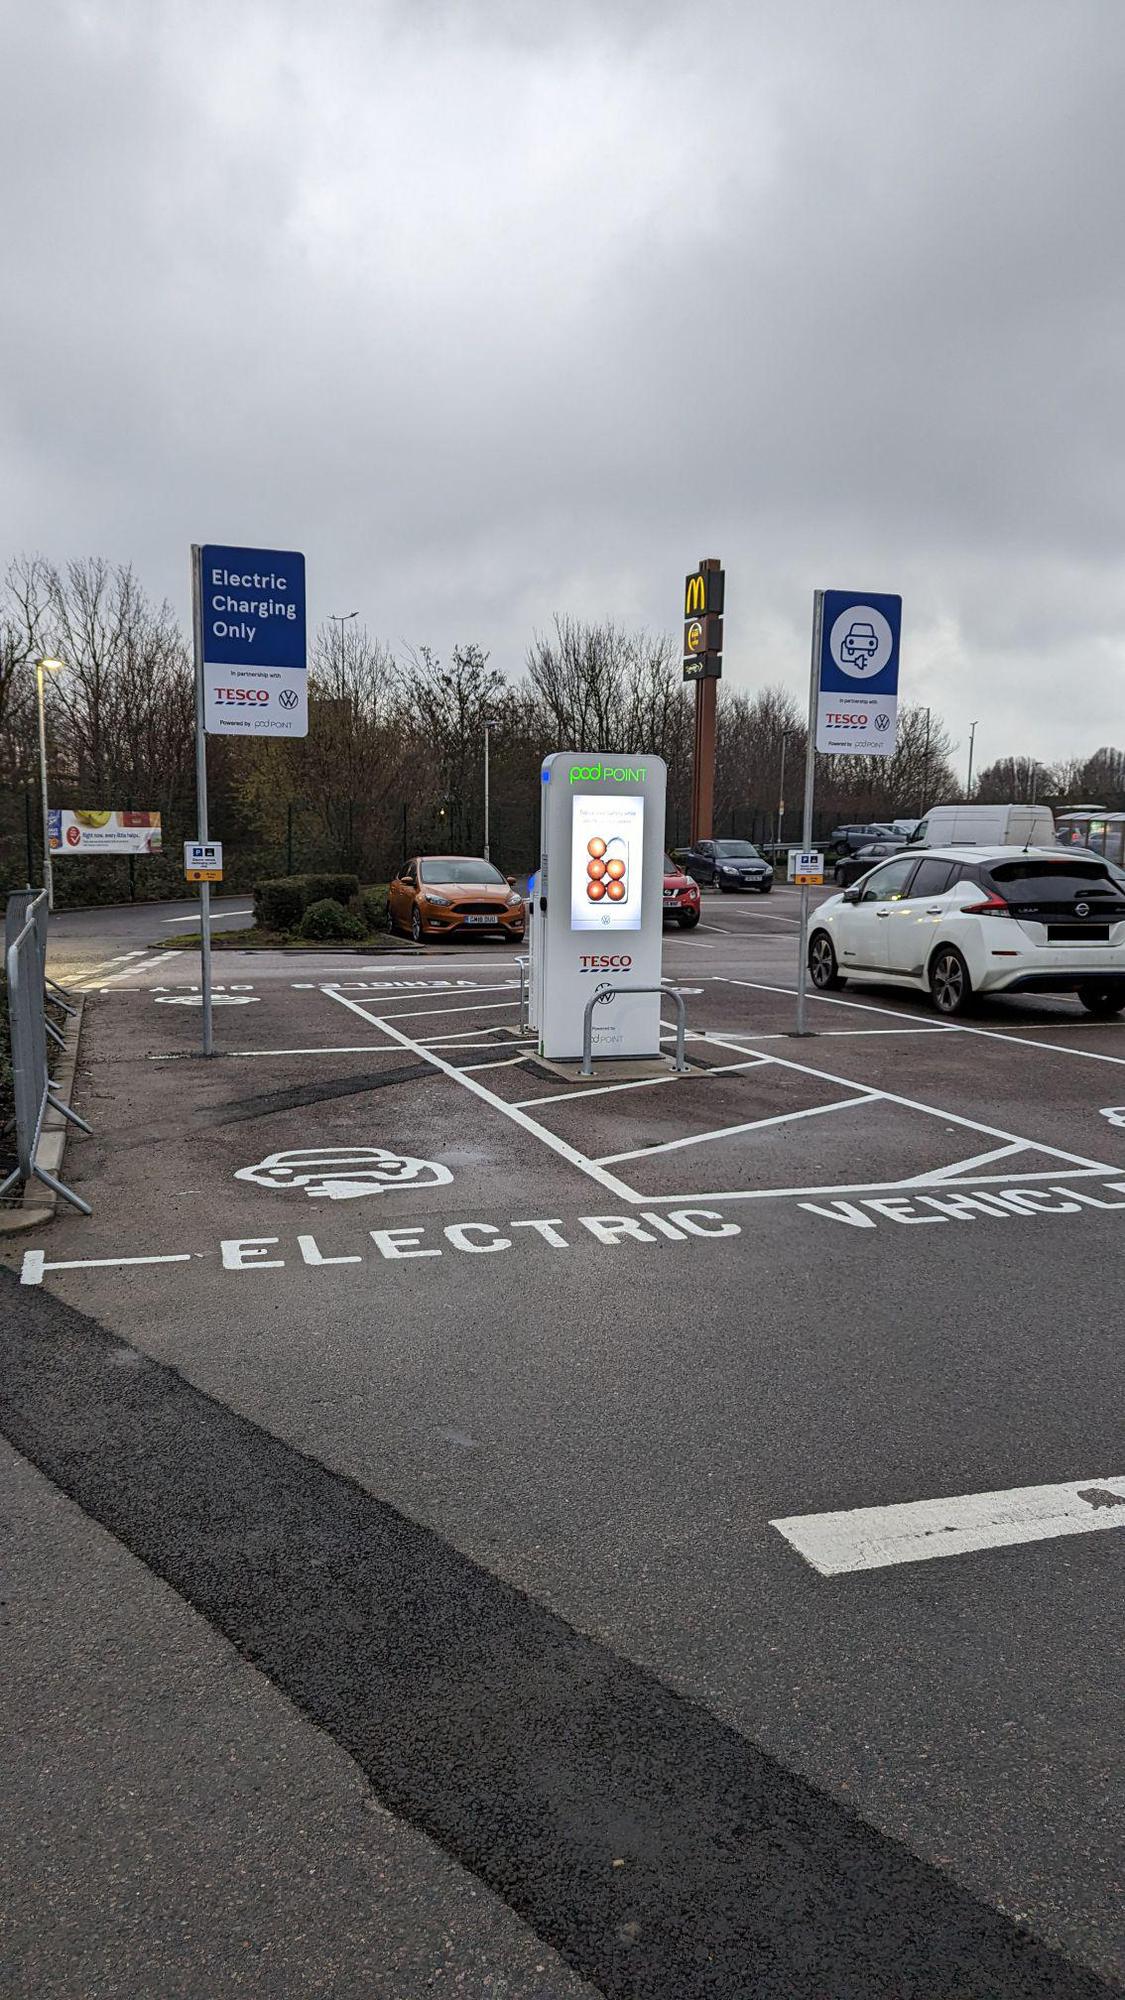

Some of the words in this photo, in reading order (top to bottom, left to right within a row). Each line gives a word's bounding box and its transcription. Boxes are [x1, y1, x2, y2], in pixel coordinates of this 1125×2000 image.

[211, 569, 287, 590] Electric
[211, 595, 297, 620] Charging
[212, 621, 257, 643] Only
[237, 671, 269, 679] partnership
[213, 687, 270, 702] TESCO
[219, 719, 243, 727] Powered
[244, 720, 251, 728] by
[270, 721, 292, 729] POINT
[825, 713, 868, 725] TESCO
[569, 762, 602, 785] pod
[603, 767, 648, 782] POINT
[579, 955, 632, 967] TESCO
[220, 1208, 742, 1270] ELECTRIC
